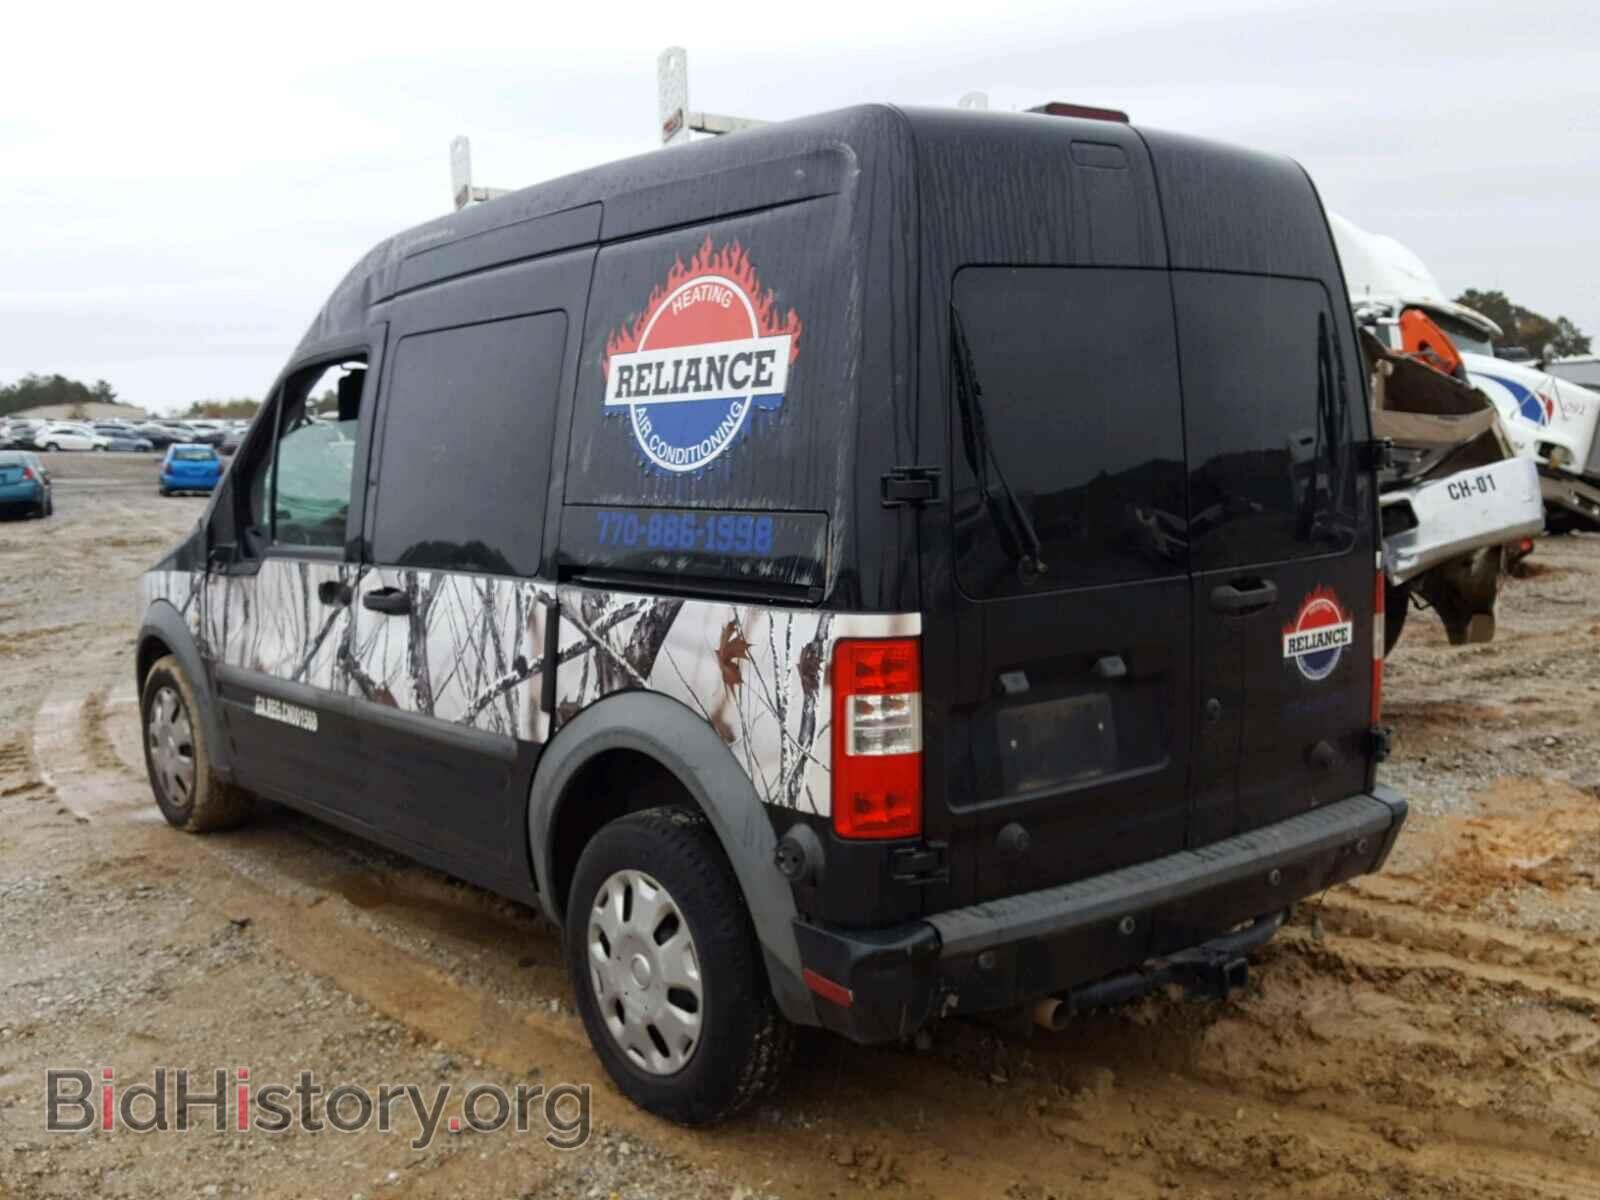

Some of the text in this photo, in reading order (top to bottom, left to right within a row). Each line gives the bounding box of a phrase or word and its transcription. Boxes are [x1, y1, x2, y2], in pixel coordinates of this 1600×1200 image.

[671, 284, 734, 316] HEATING
[614, 350, 776, 399] RELIANCE
[636, 401, 743, 464] AIR CONDITIONING
[1447, 474, 1496, 500] CH-01
[596, 511, 773, 556] 770-886-1998
[1287, 627, 1348, 654] RELIANCE
